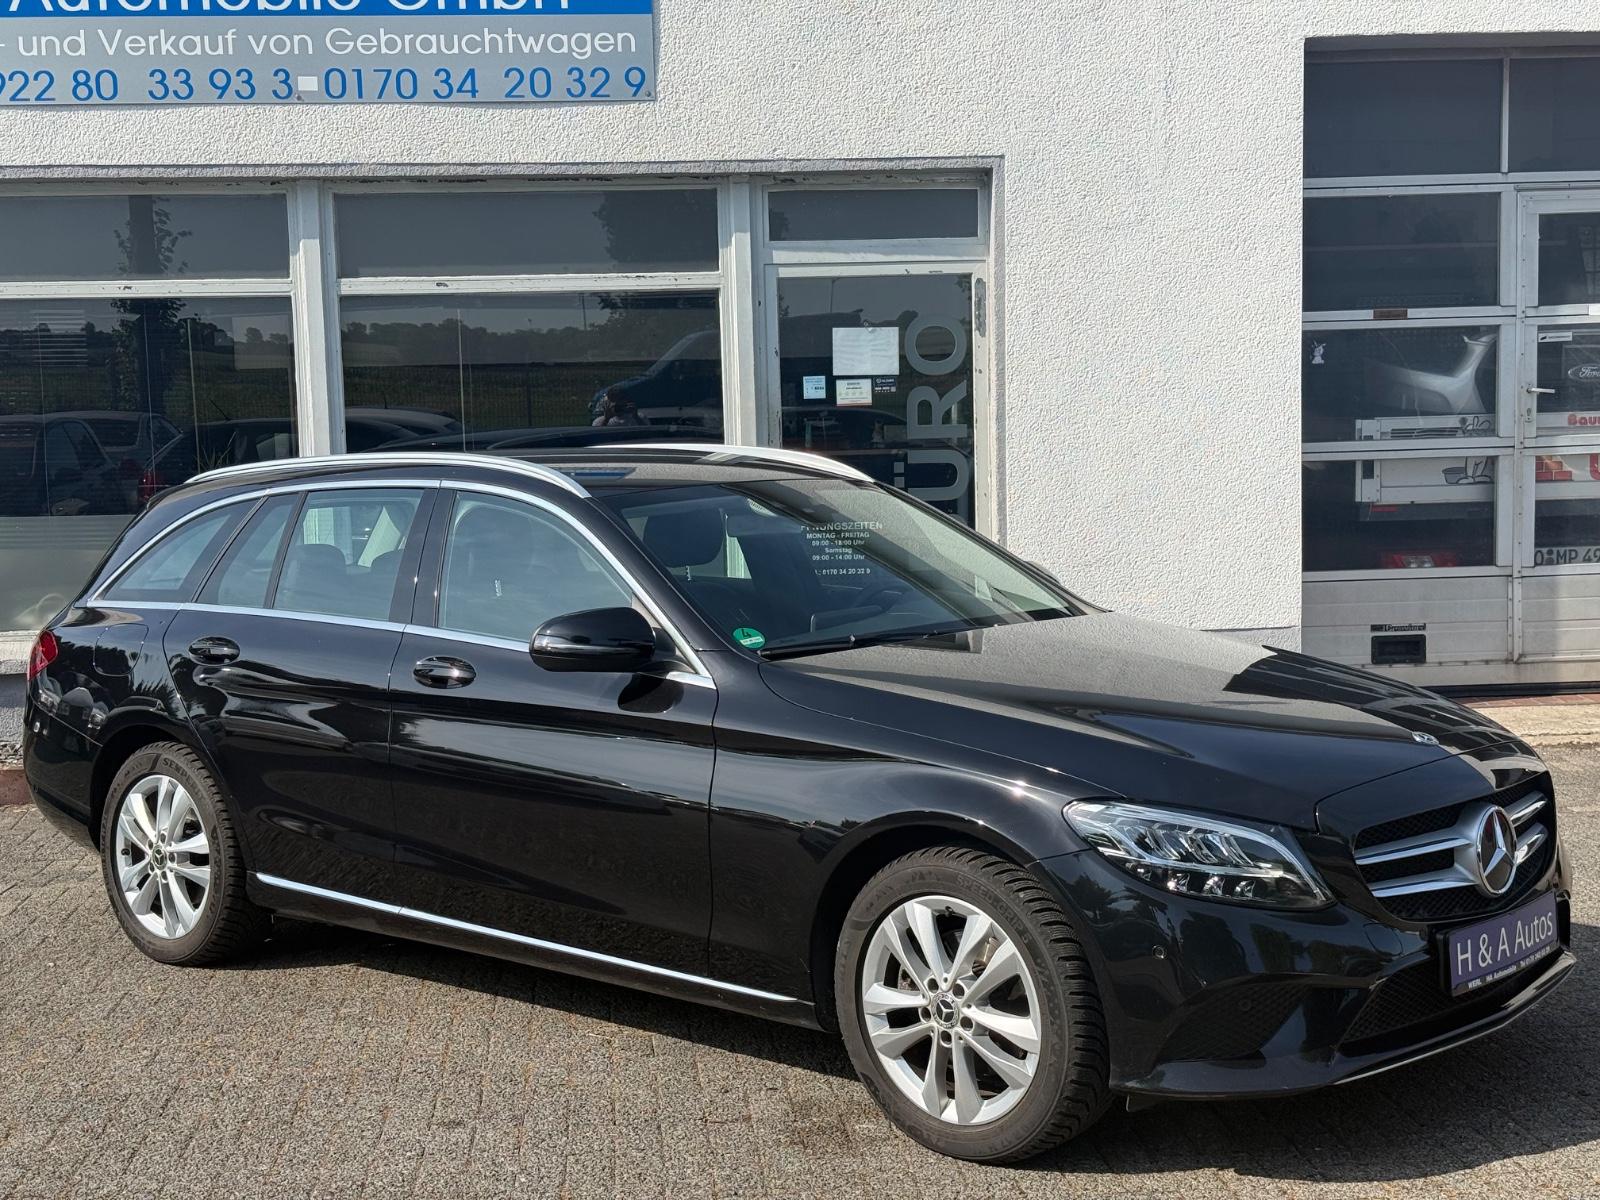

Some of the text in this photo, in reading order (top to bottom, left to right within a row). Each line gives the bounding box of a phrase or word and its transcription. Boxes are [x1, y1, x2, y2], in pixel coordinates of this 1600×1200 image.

[18, 27, 637, 60] und Verkauf von Gebrauchtwagen
[0, 66, 647, 102] 22 80 33 93 3 0170 34 20 32 9
[893, 315, 970, 527] ÜRO
[1567, 413, 1600, 426] Bau
[1556, 548, 1578, 565] MP
[1457, 939, 1473, 976] H
[1478, 933, 1493, 968] &
[1497, 927, 1510, 961] A
[1514, 911, 1553, 955] Autos
